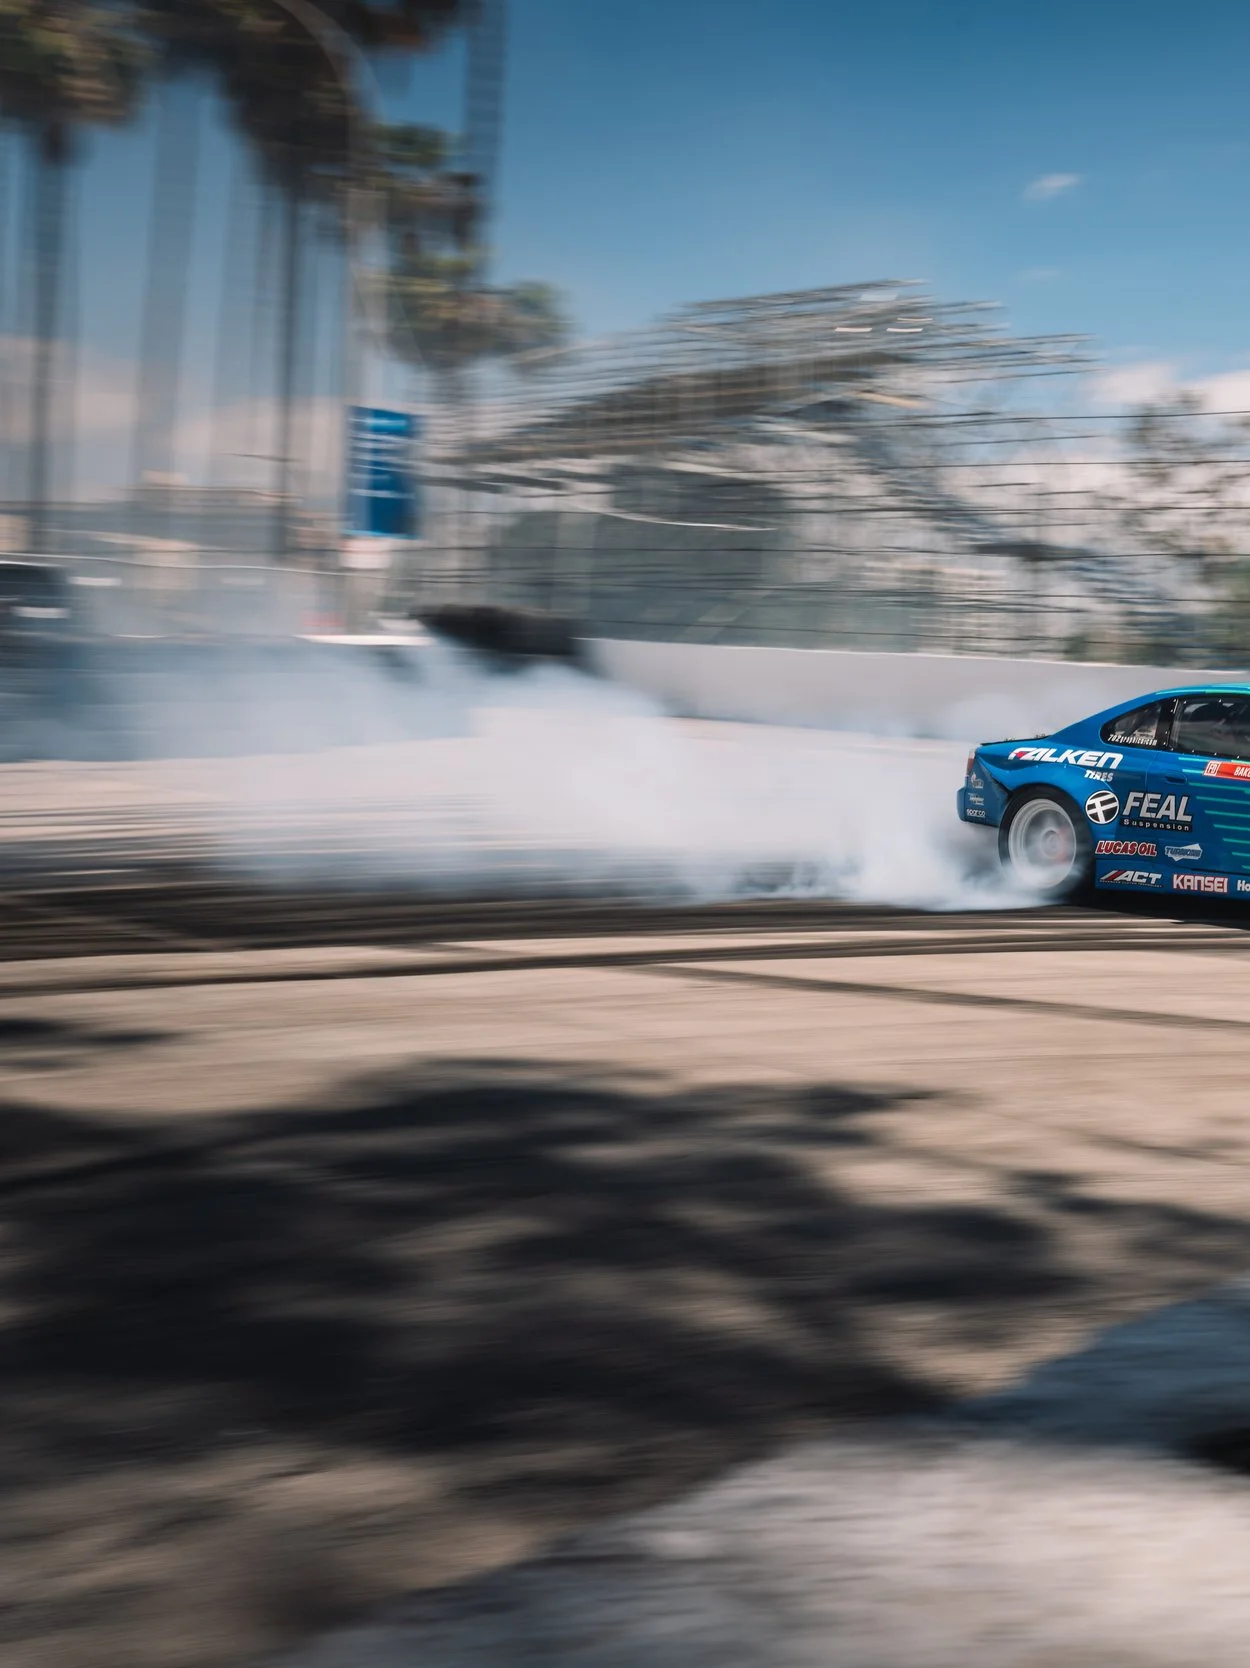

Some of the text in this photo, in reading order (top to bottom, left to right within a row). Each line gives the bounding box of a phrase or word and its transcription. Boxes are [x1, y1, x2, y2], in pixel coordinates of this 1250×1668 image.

[1008, 747, 1124, 770] FALKEN
[1122, 791, 1193, 822] FEAL
[1123, 818, 1190, 832] Suspension
[1095, 841, 1139, 856] LUCAS
[1138, 842, 1158, 857] OIL
[1114, 870, 1162, 885] ACT
[1173, 874, 1228, 893] KANSEI
